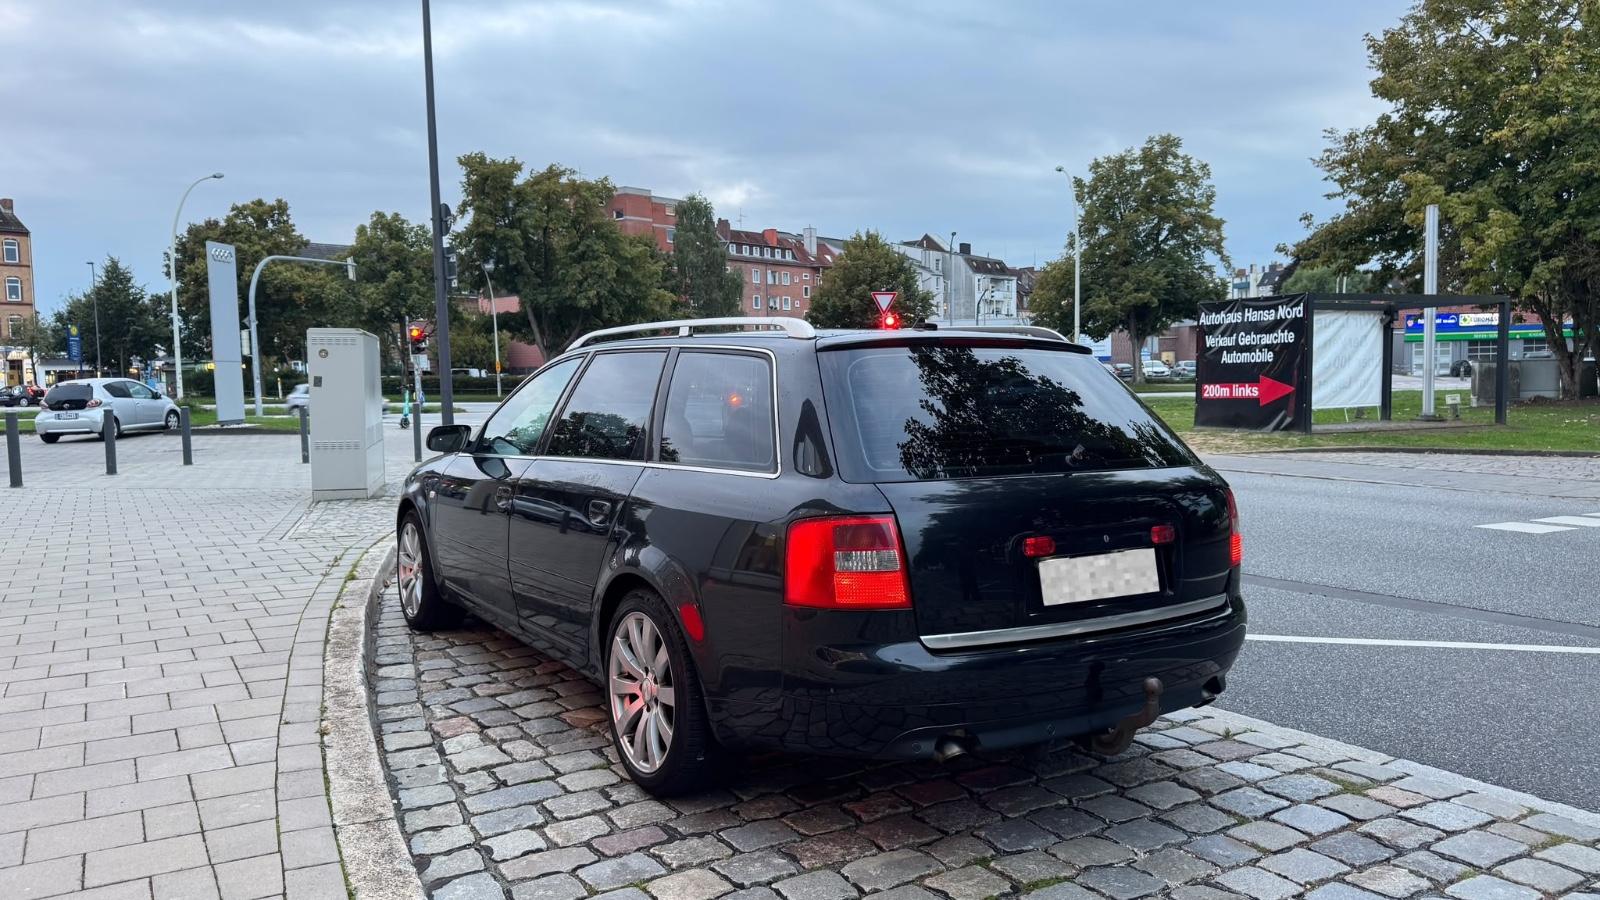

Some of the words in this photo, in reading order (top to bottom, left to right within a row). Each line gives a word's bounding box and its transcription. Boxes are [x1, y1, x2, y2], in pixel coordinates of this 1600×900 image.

[1199, 311, 1242, 325] Autohaus
[1244, 308, 1275, 321] Hansa
[1277, 303, 1304, 319] Nord
[1205, 333, 1236, 347] Verkauf
[1238, 330, 1295, 346] Gebrauchte
[1221, 349, 1274, 364] Automobile
[1203, 384, 1229, 397] 200m
[1232, 384, 1259, 397] links
